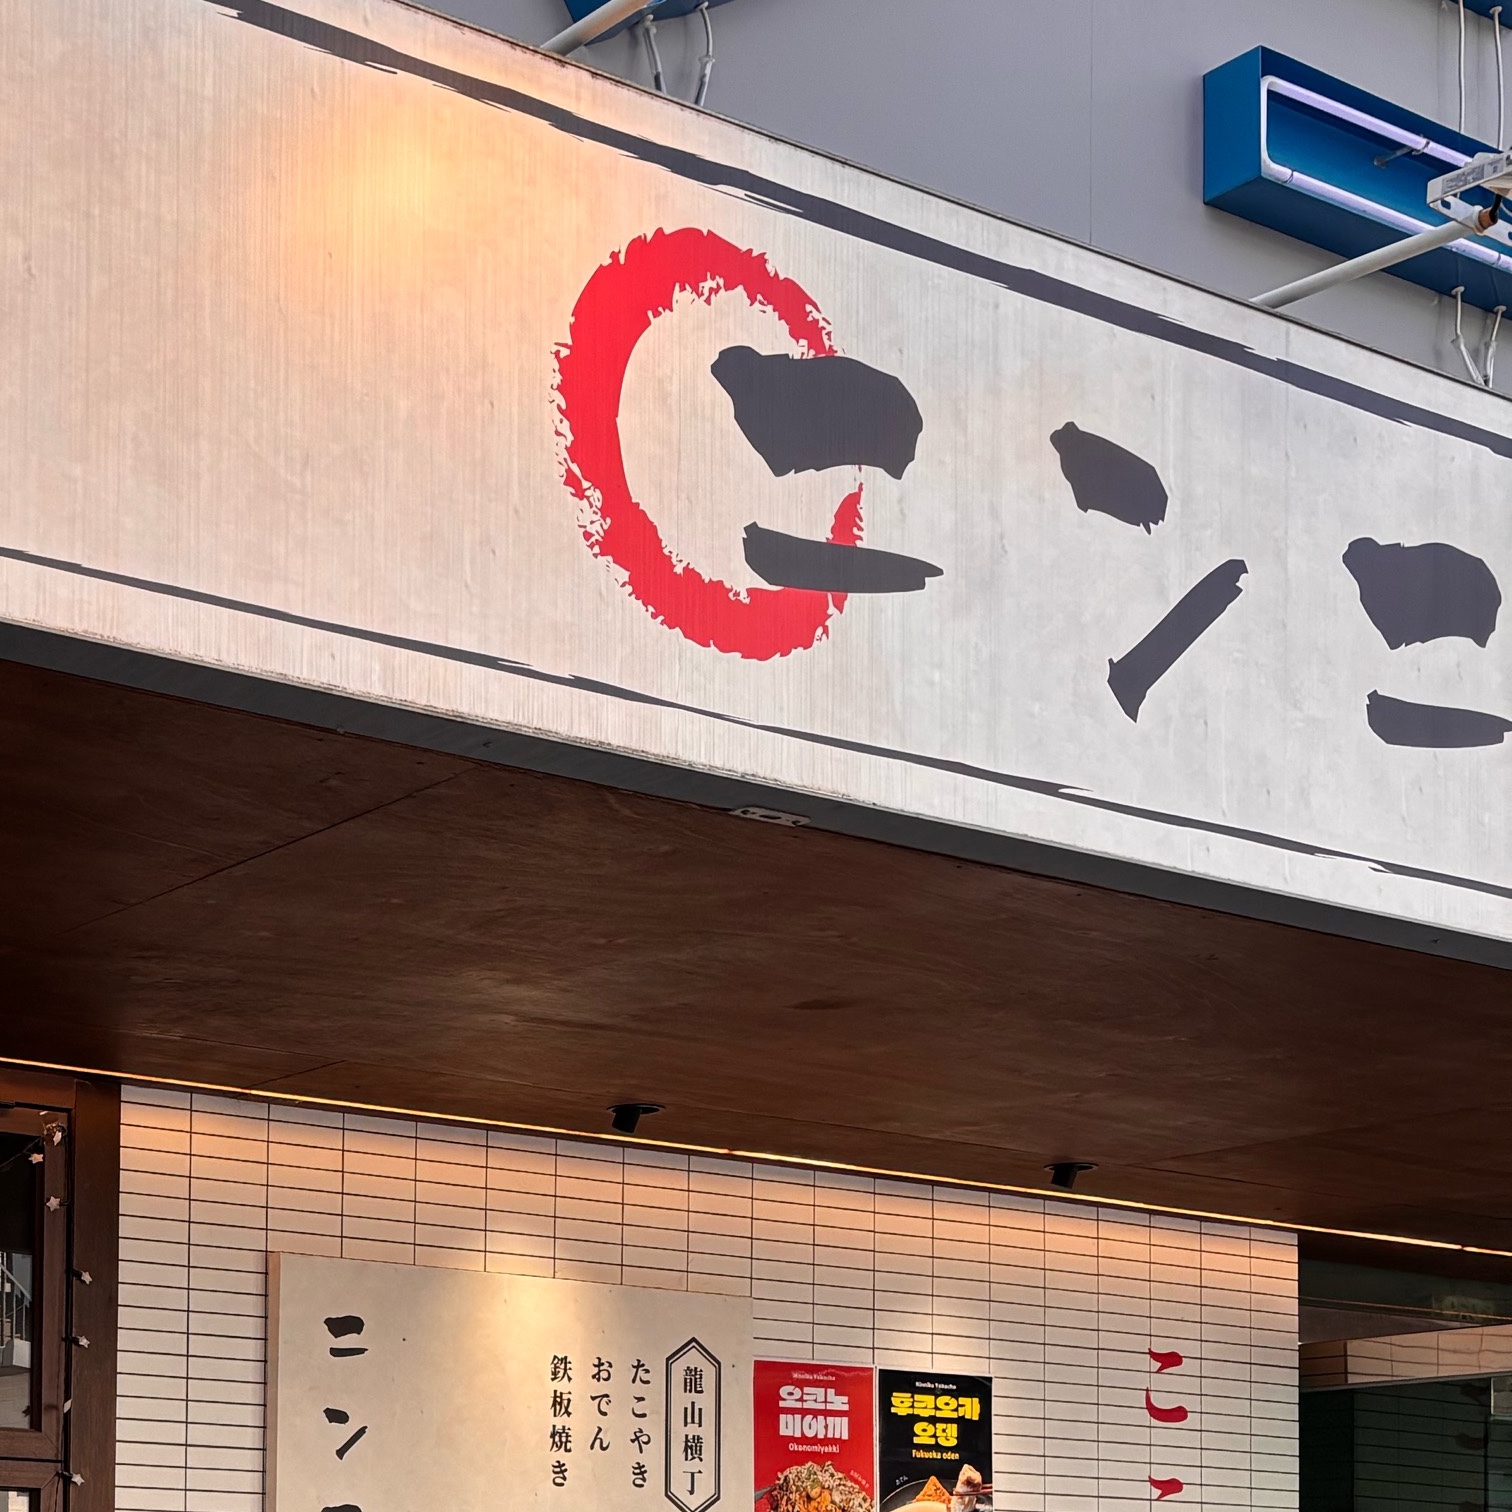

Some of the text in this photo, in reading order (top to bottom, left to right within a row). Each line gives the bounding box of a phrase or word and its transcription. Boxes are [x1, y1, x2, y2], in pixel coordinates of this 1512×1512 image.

[549, 1354, 573, 1488] 鉄板焼き
[589, 1356, 613, 1452] おでん
[629, 1358, 652, 1489] たこやき
[778, 1385, 849, 1411] 오코노
[779, 1413, 849, 1440] 미야끼
[890, 1391, 981, 1421] 후쿠오카
[682, 1365, 704, 1496] 龍山横丁
[913, 1421, 958, 1447] 오뎅
